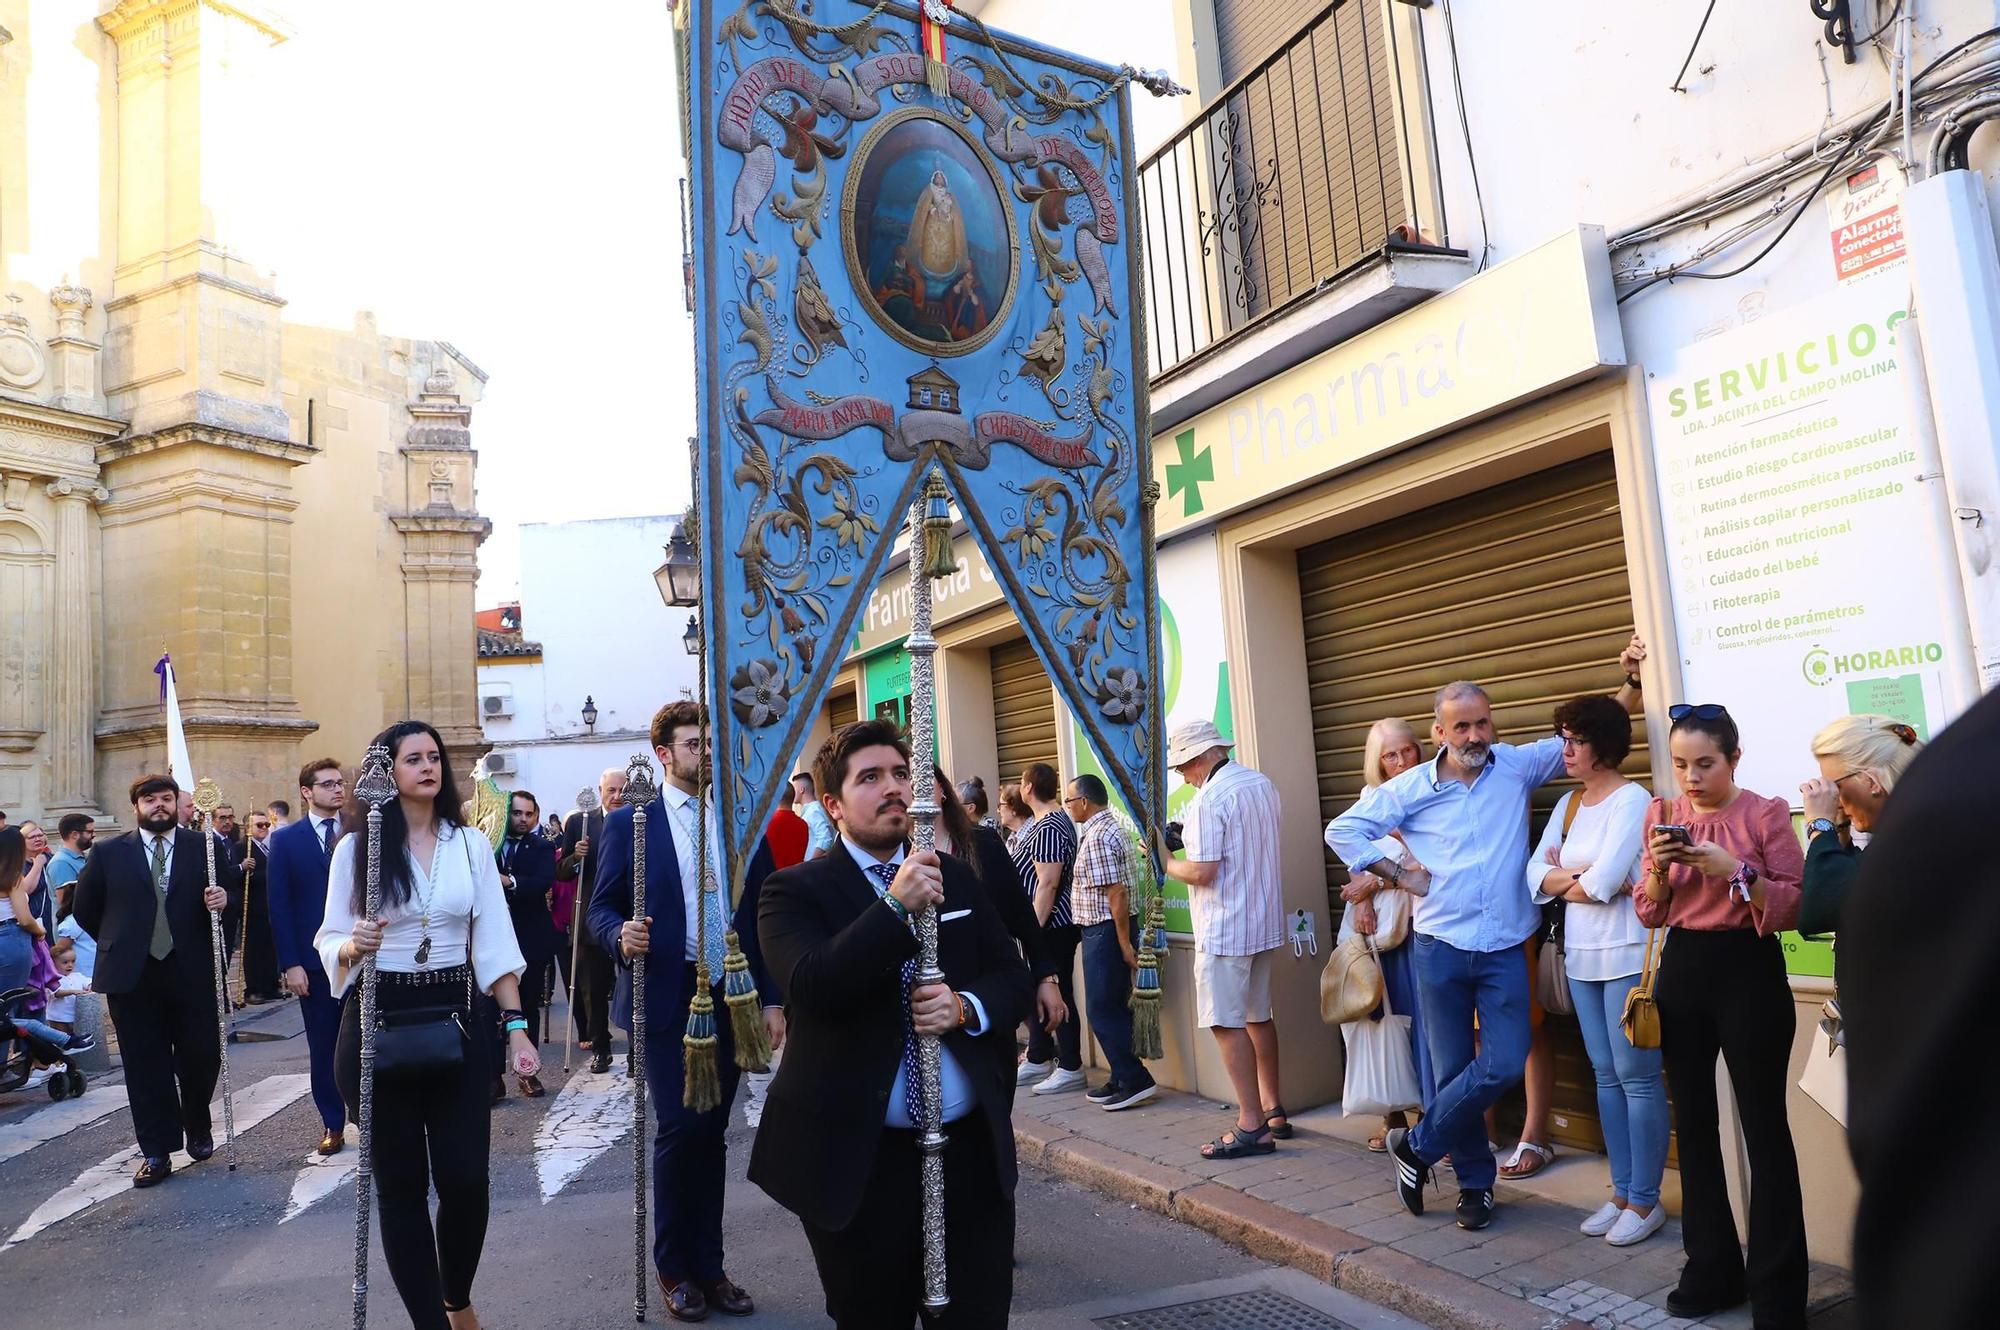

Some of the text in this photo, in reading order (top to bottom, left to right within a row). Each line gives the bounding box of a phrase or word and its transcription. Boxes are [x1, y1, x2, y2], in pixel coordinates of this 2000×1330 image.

[876, 57, 988, 107] SOCRO
[1839, 210, 1901, 244] Alarma
[1682, 358, 1897, 436] LDA. JACINTA DEL CAMPO MOLINA
[1694, 416, 1838, 466] Atención farmacéutica
[1697, 427, 1899, 490] Estudio Riesgo Cardiovascular
[1700, 497, 1737, 514] Rutina
[1740, 470, 1841, 504] dermocosmética
[1703, 481, 1904, 539] Análisis capilar personalizado
[1706, 519, 1852, 562] Educación nutricional
[1709, 551, 1820, 587] Cuidado del bebé
[868, 555, 971, 632] Farcia
[1712, 587, 1781, 611] Fitoterapia
[1716, 604, 1865, 638] Control de parámetros
[1833, 642, 1943, 674] HORARIO
